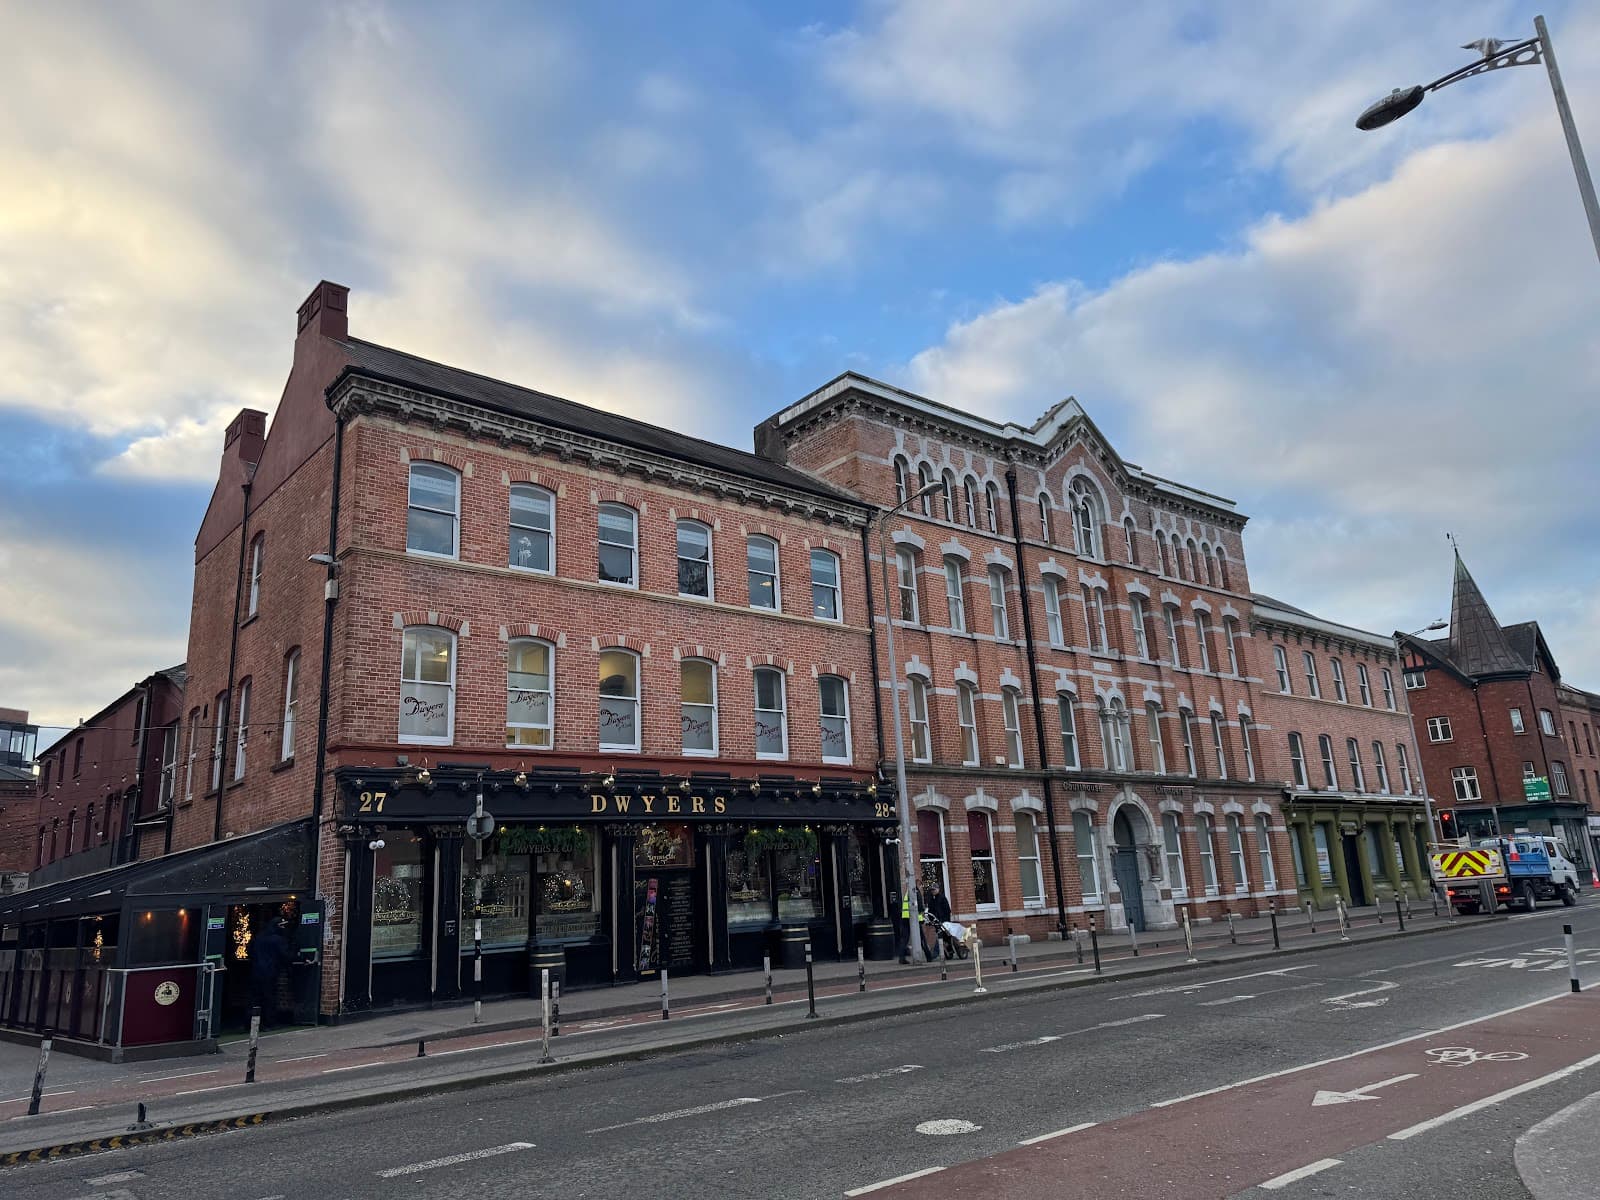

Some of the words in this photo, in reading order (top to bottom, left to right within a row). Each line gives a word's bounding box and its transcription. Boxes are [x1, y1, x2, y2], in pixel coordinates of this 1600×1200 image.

[359, 791, 387, 813] 27
[590, 794, 726, 813] DWYERS
[874, 802, 890, 818] 28
